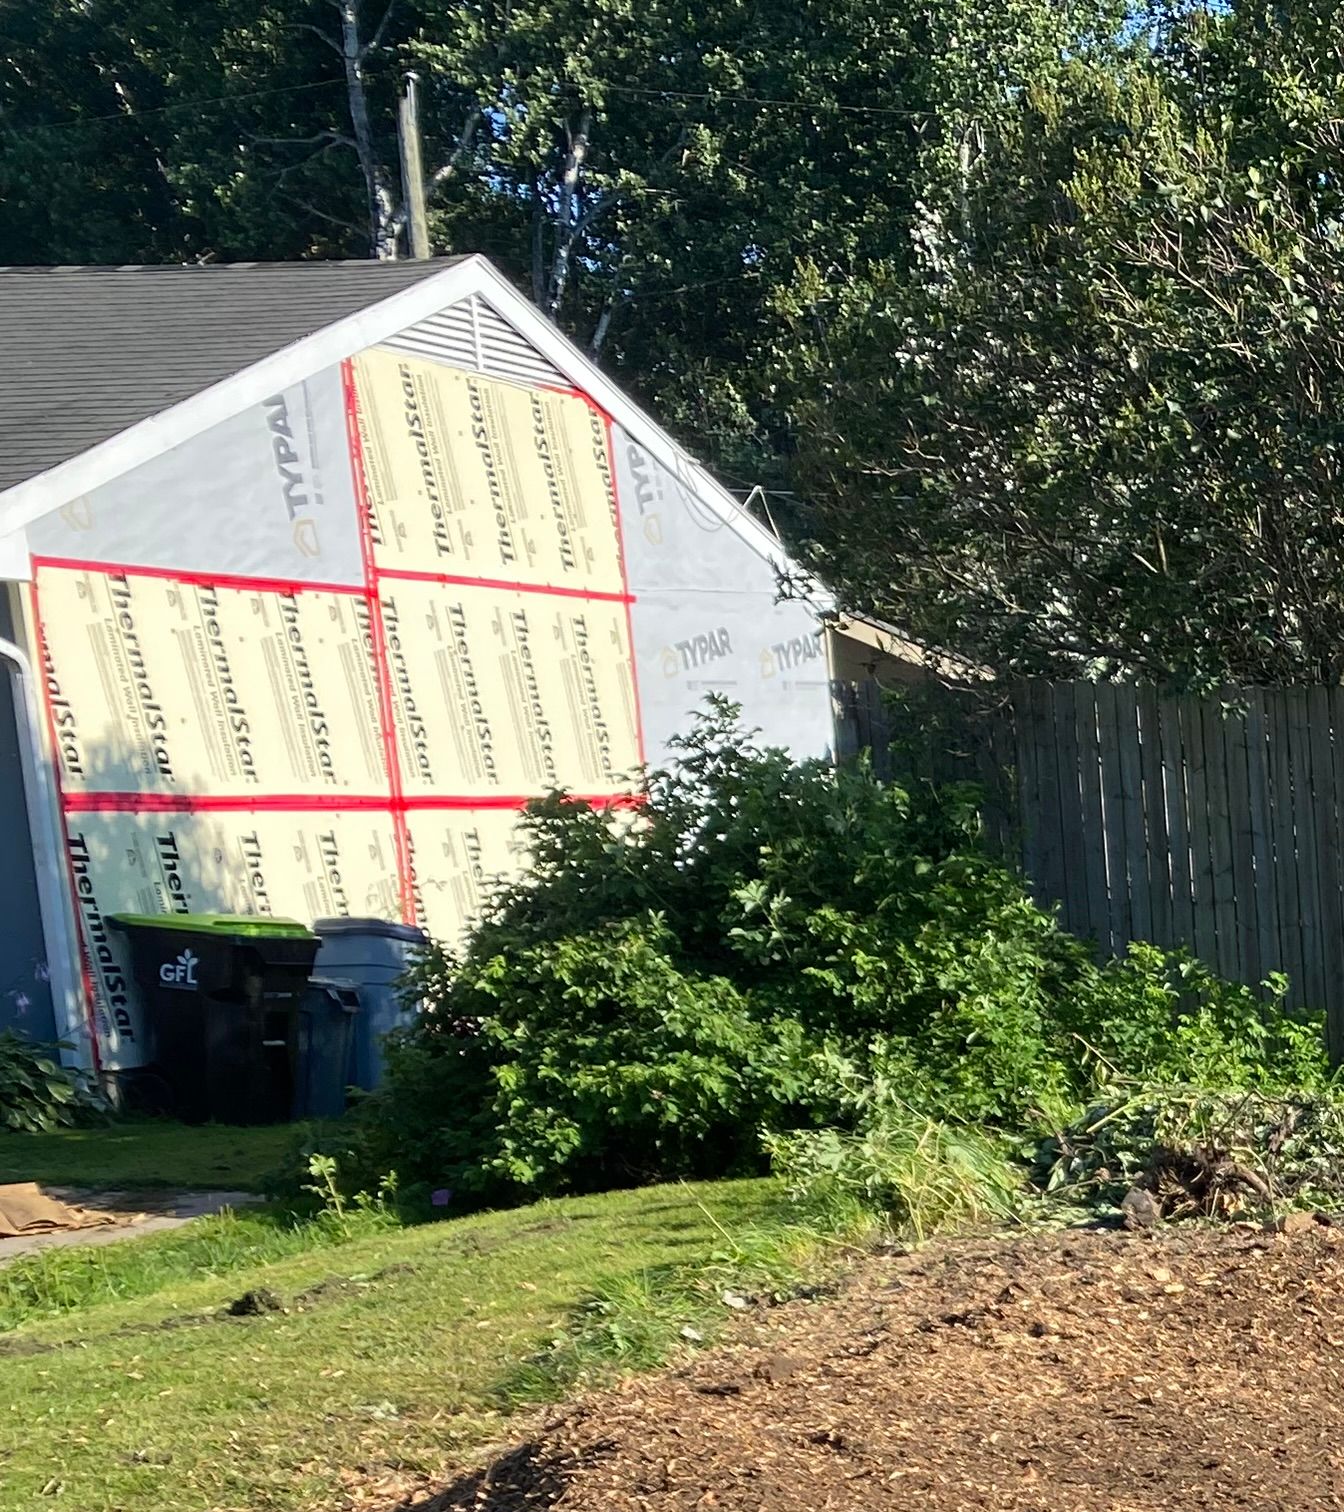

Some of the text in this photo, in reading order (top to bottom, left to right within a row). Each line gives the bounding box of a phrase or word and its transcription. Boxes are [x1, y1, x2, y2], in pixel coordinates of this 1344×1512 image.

[627, 436, 656, 516] TYP
[674, 627, 733, 671] TYPAR
[160, 959, 198, 984] GFL
